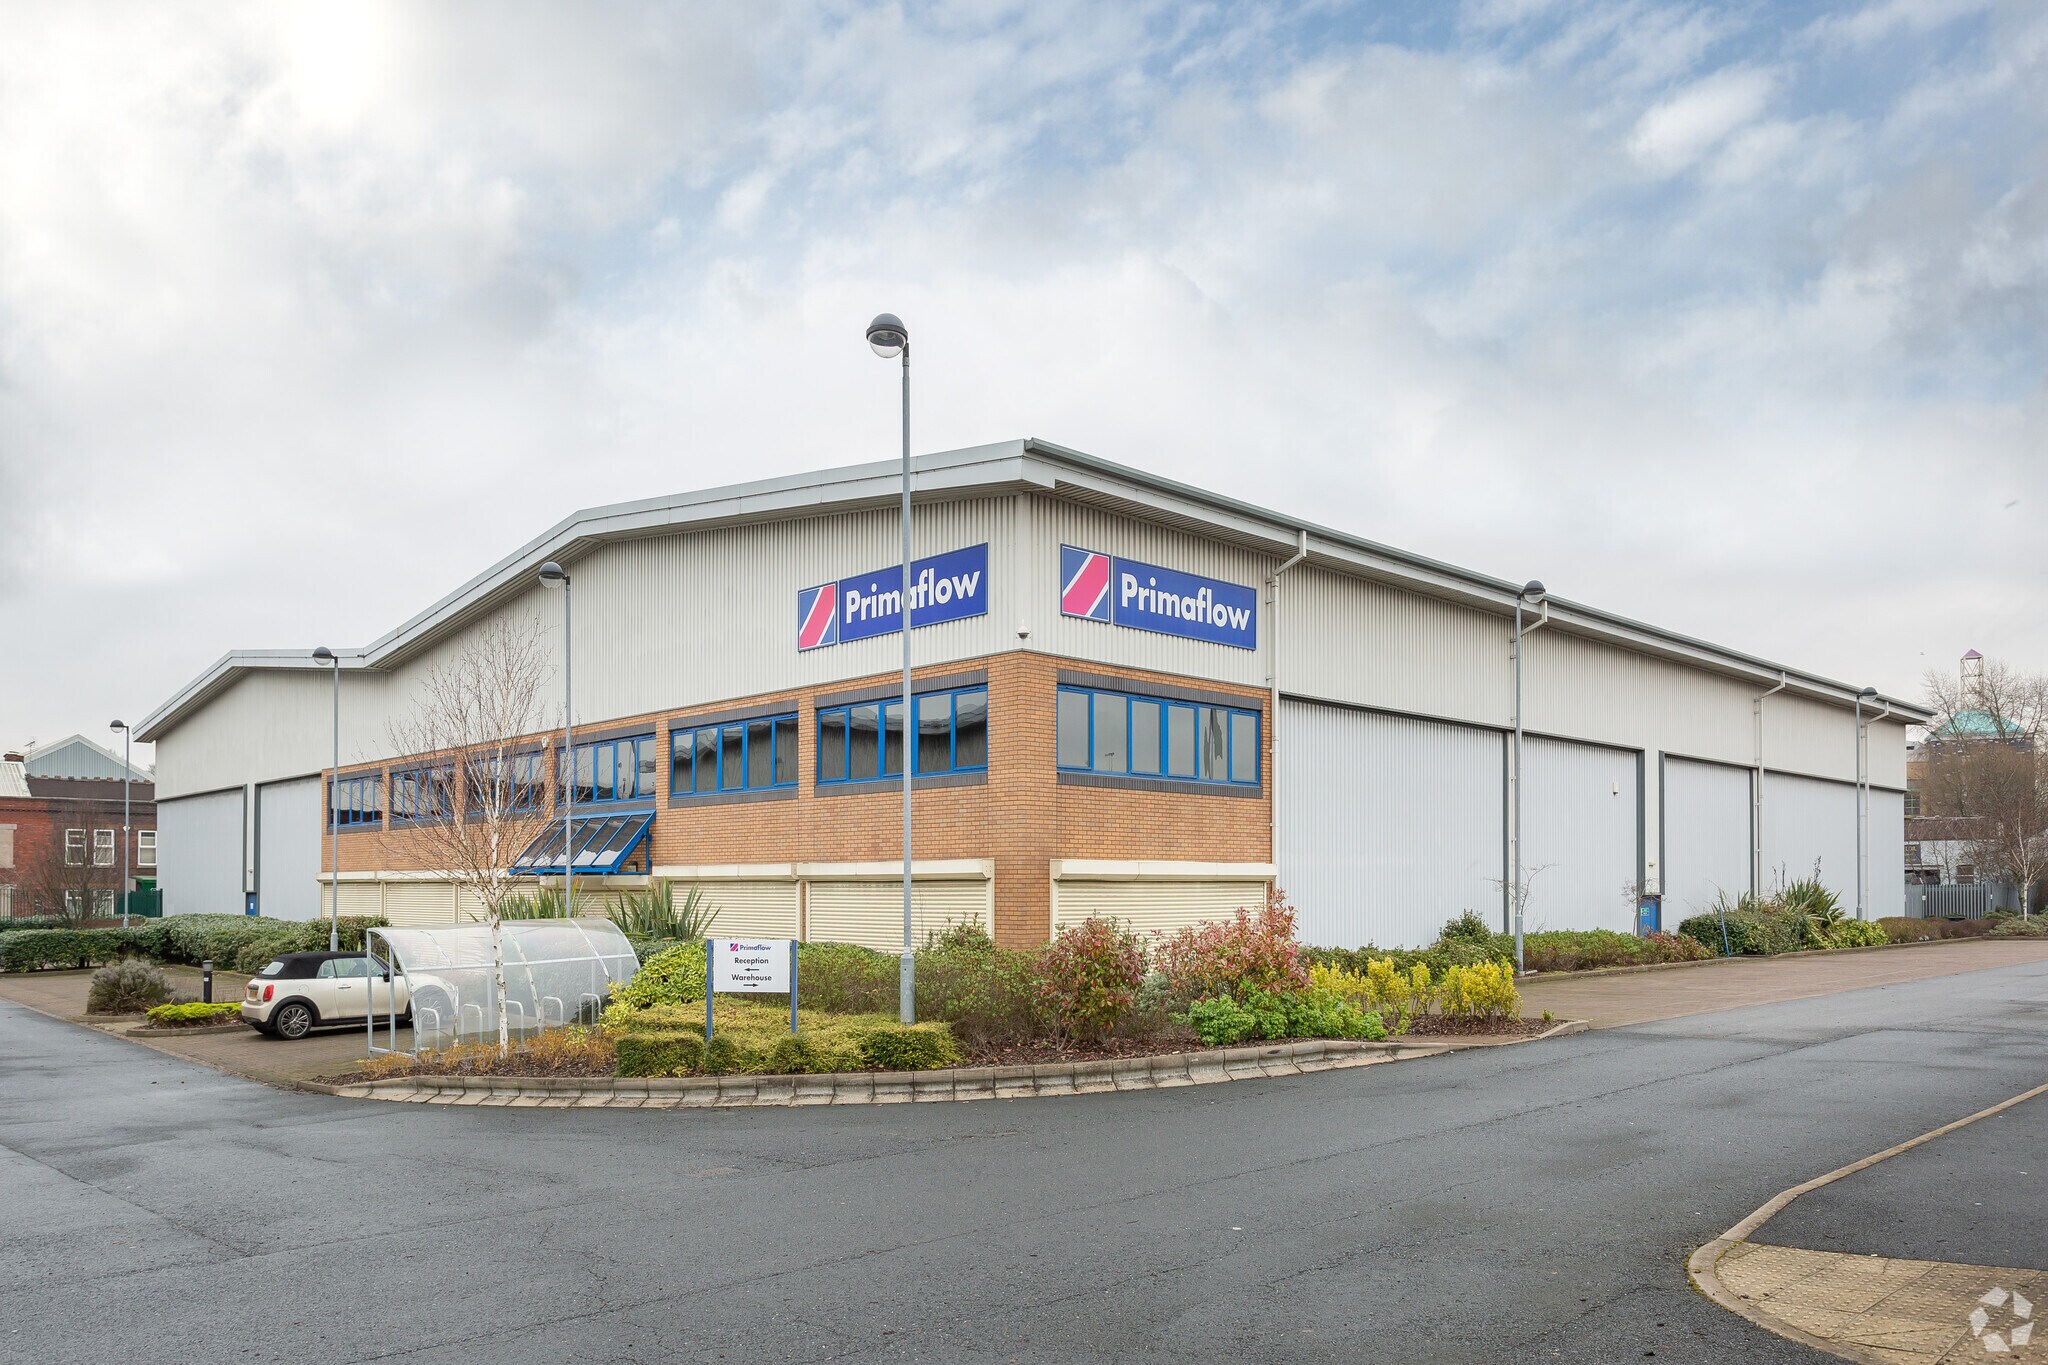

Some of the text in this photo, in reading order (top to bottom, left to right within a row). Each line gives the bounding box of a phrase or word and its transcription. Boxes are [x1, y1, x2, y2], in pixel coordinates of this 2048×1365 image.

[1121, 572, 1250, 631] Primaflow
[734, 957, 769, 966] Reception
[731, 973, 772, 981] Warehouse
